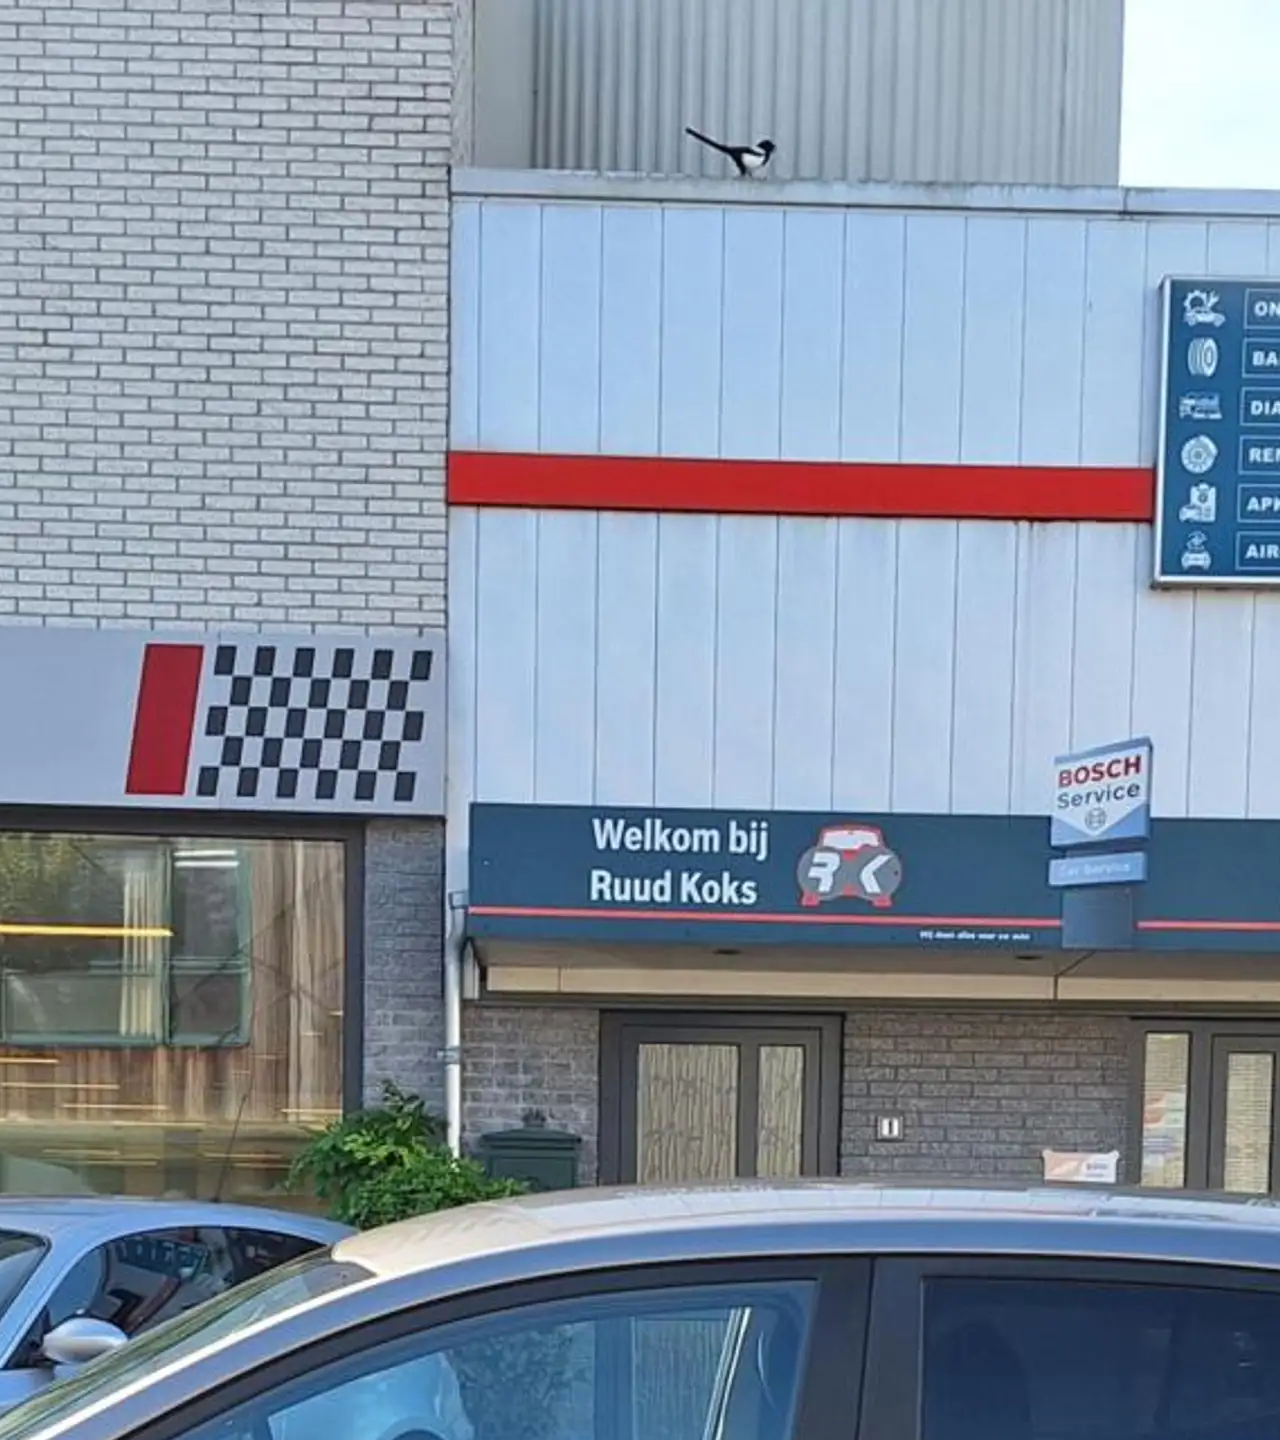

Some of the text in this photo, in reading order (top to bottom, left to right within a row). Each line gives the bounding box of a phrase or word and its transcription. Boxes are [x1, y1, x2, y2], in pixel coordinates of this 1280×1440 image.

[1058, 754, 1142, 789] BOSCH
[1056, 782, 1141, 809] Service
[591, 817, 769, 861] Welkom bij
[590, 869, 759, 906] Ruud Koks
